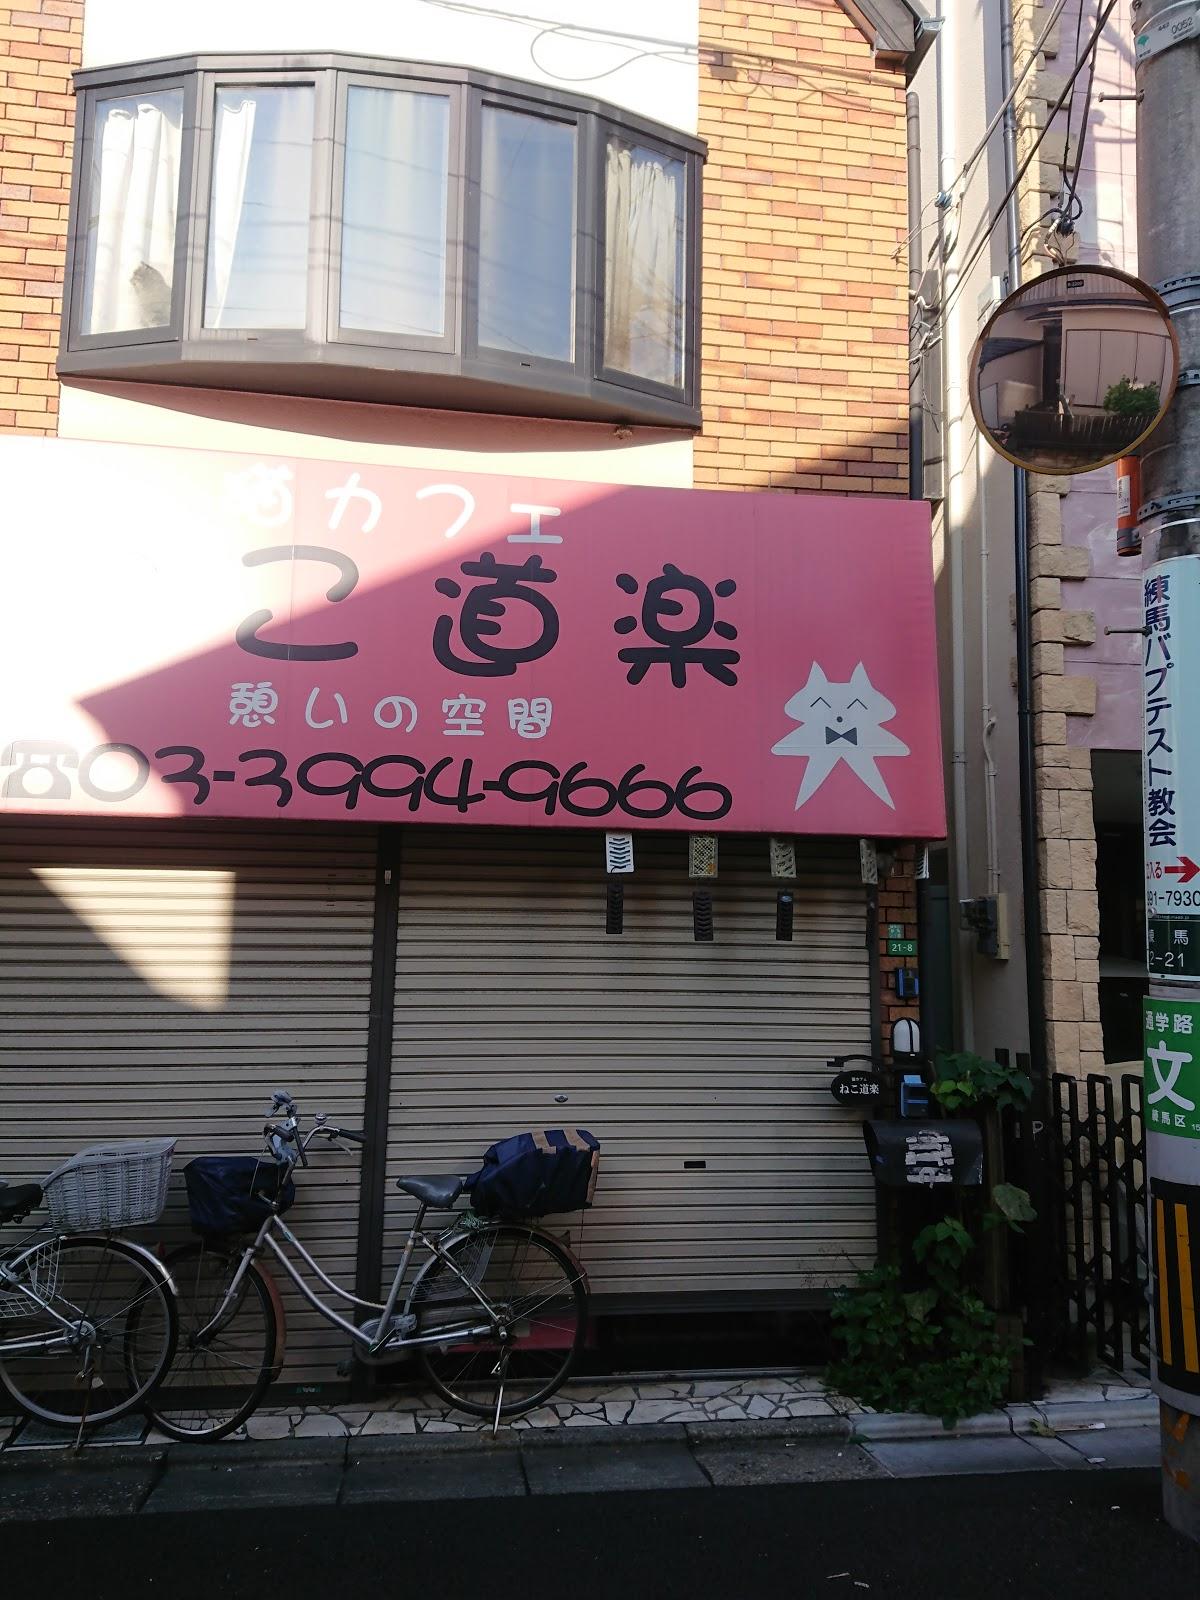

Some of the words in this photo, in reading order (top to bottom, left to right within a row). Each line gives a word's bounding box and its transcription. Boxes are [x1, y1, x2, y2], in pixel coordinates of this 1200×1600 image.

[235, 544, 741, 688] こ道楽
[229, 682, 552, 739] 憩いの空間
[1144, 574, 1177, 848] 練馬バプテスト教会
[78, 742, 733, 821] 03-3994-9666
[891, 943, 913, 952] 21-8
[1146, 1010, 1194, 1034] 通学路
[839, 1083, 879, 1095] ねこ道楽
[1147, 1040, 1196, 1112] 文
[1151, 1108, 1187, 1129] 練馬区
